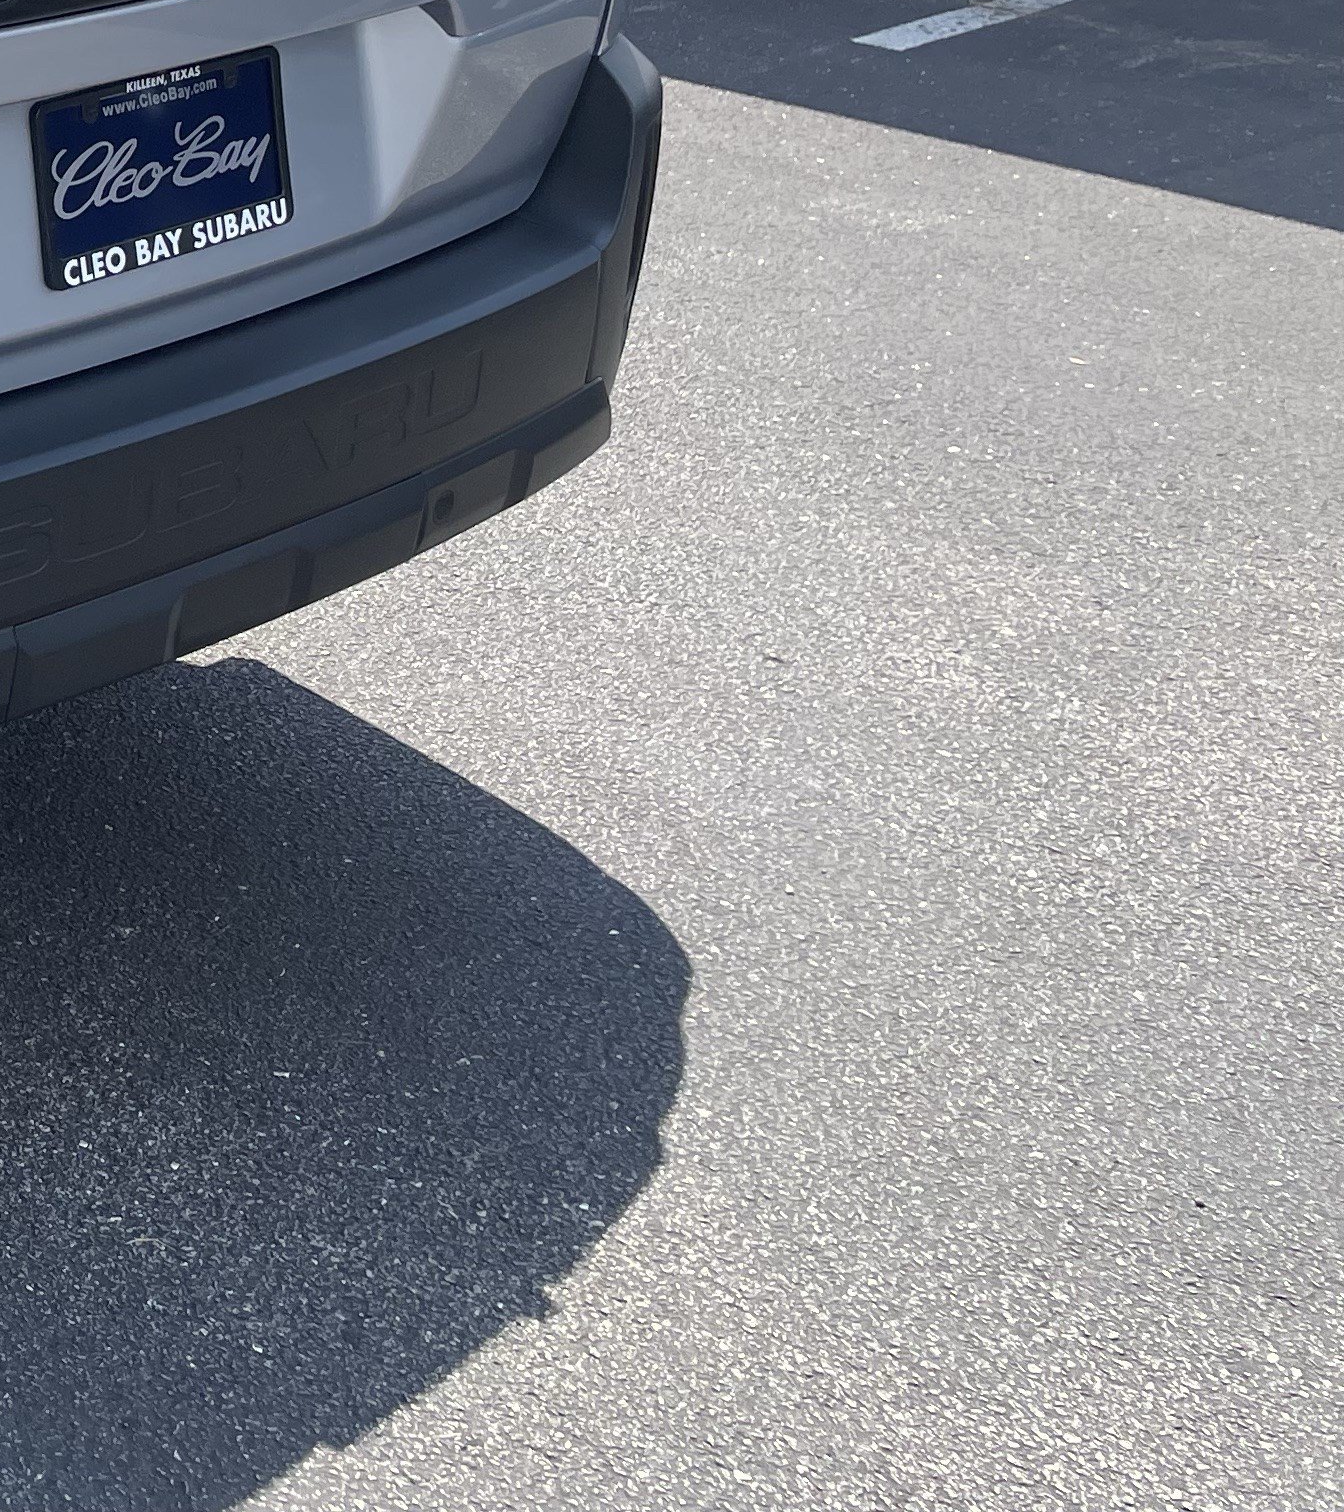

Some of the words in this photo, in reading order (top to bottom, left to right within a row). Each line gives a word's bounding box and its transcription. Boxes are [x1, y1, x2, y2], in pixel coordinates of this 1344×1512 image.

[101, 78, 218, 117] www.CleoBay.com
[125, 73, 168, 94] KILLEEN,
[169, 65, 202, 83] TEXAS
[50, 137, 175, 221] Cleo
[172, 114, 271, 187] Bay
[63, 245, 127, 287] CLEO
[134, 228, 183, 267] BAY
[191, 197, 288, 250] SUBARU
